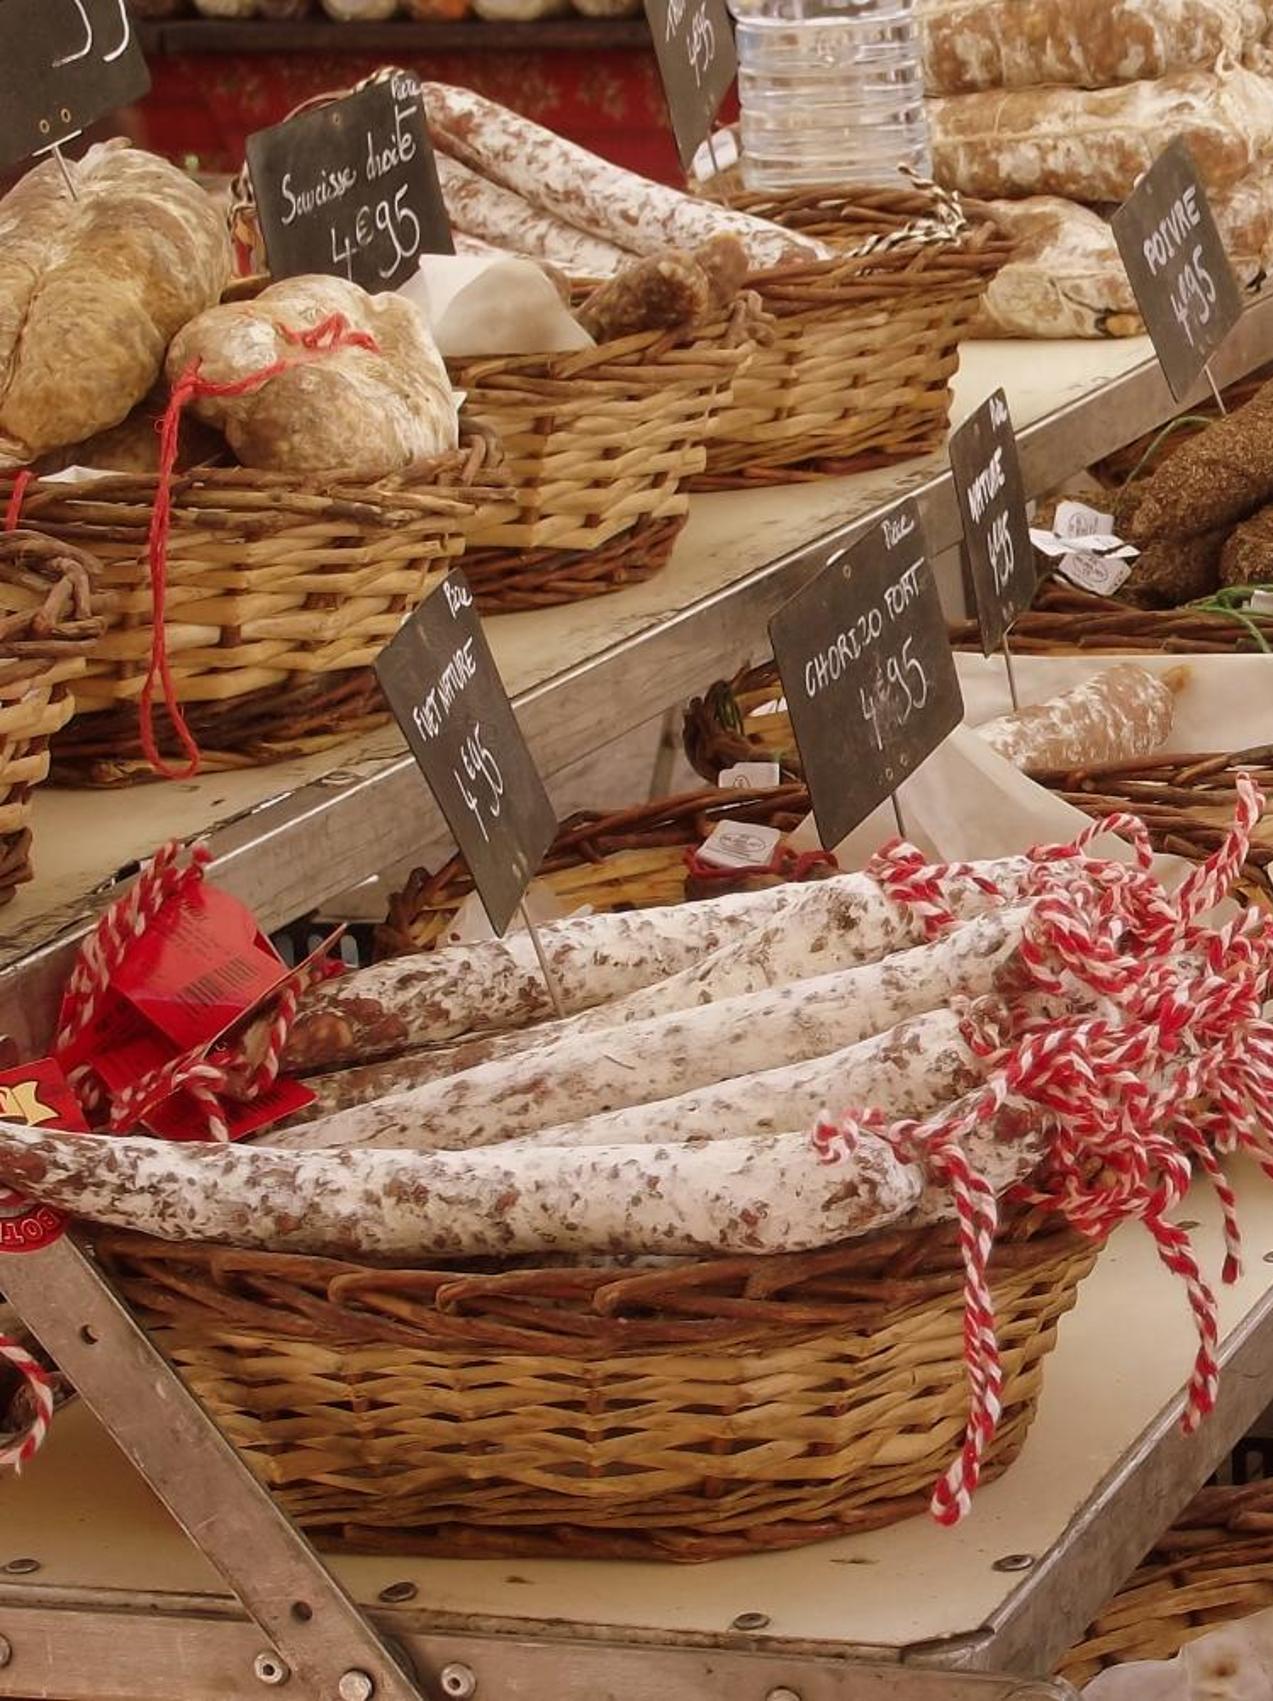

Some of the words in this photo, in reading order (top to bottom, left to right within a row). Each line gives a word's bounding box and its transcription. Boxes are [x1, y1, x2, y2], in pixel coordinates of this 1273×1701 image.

[331, 184, 420, 281] 4€95
[1143, 184, 1201, 276] POIVRE
[1170, 244, 1216, 347] 4€95
[804, 608, 883, 698] CHORIZO
[884, 557, 925, 620] FORT
[454, 721, 503, 842] 4€95
[0, 1206, 61, 1245] BOT
